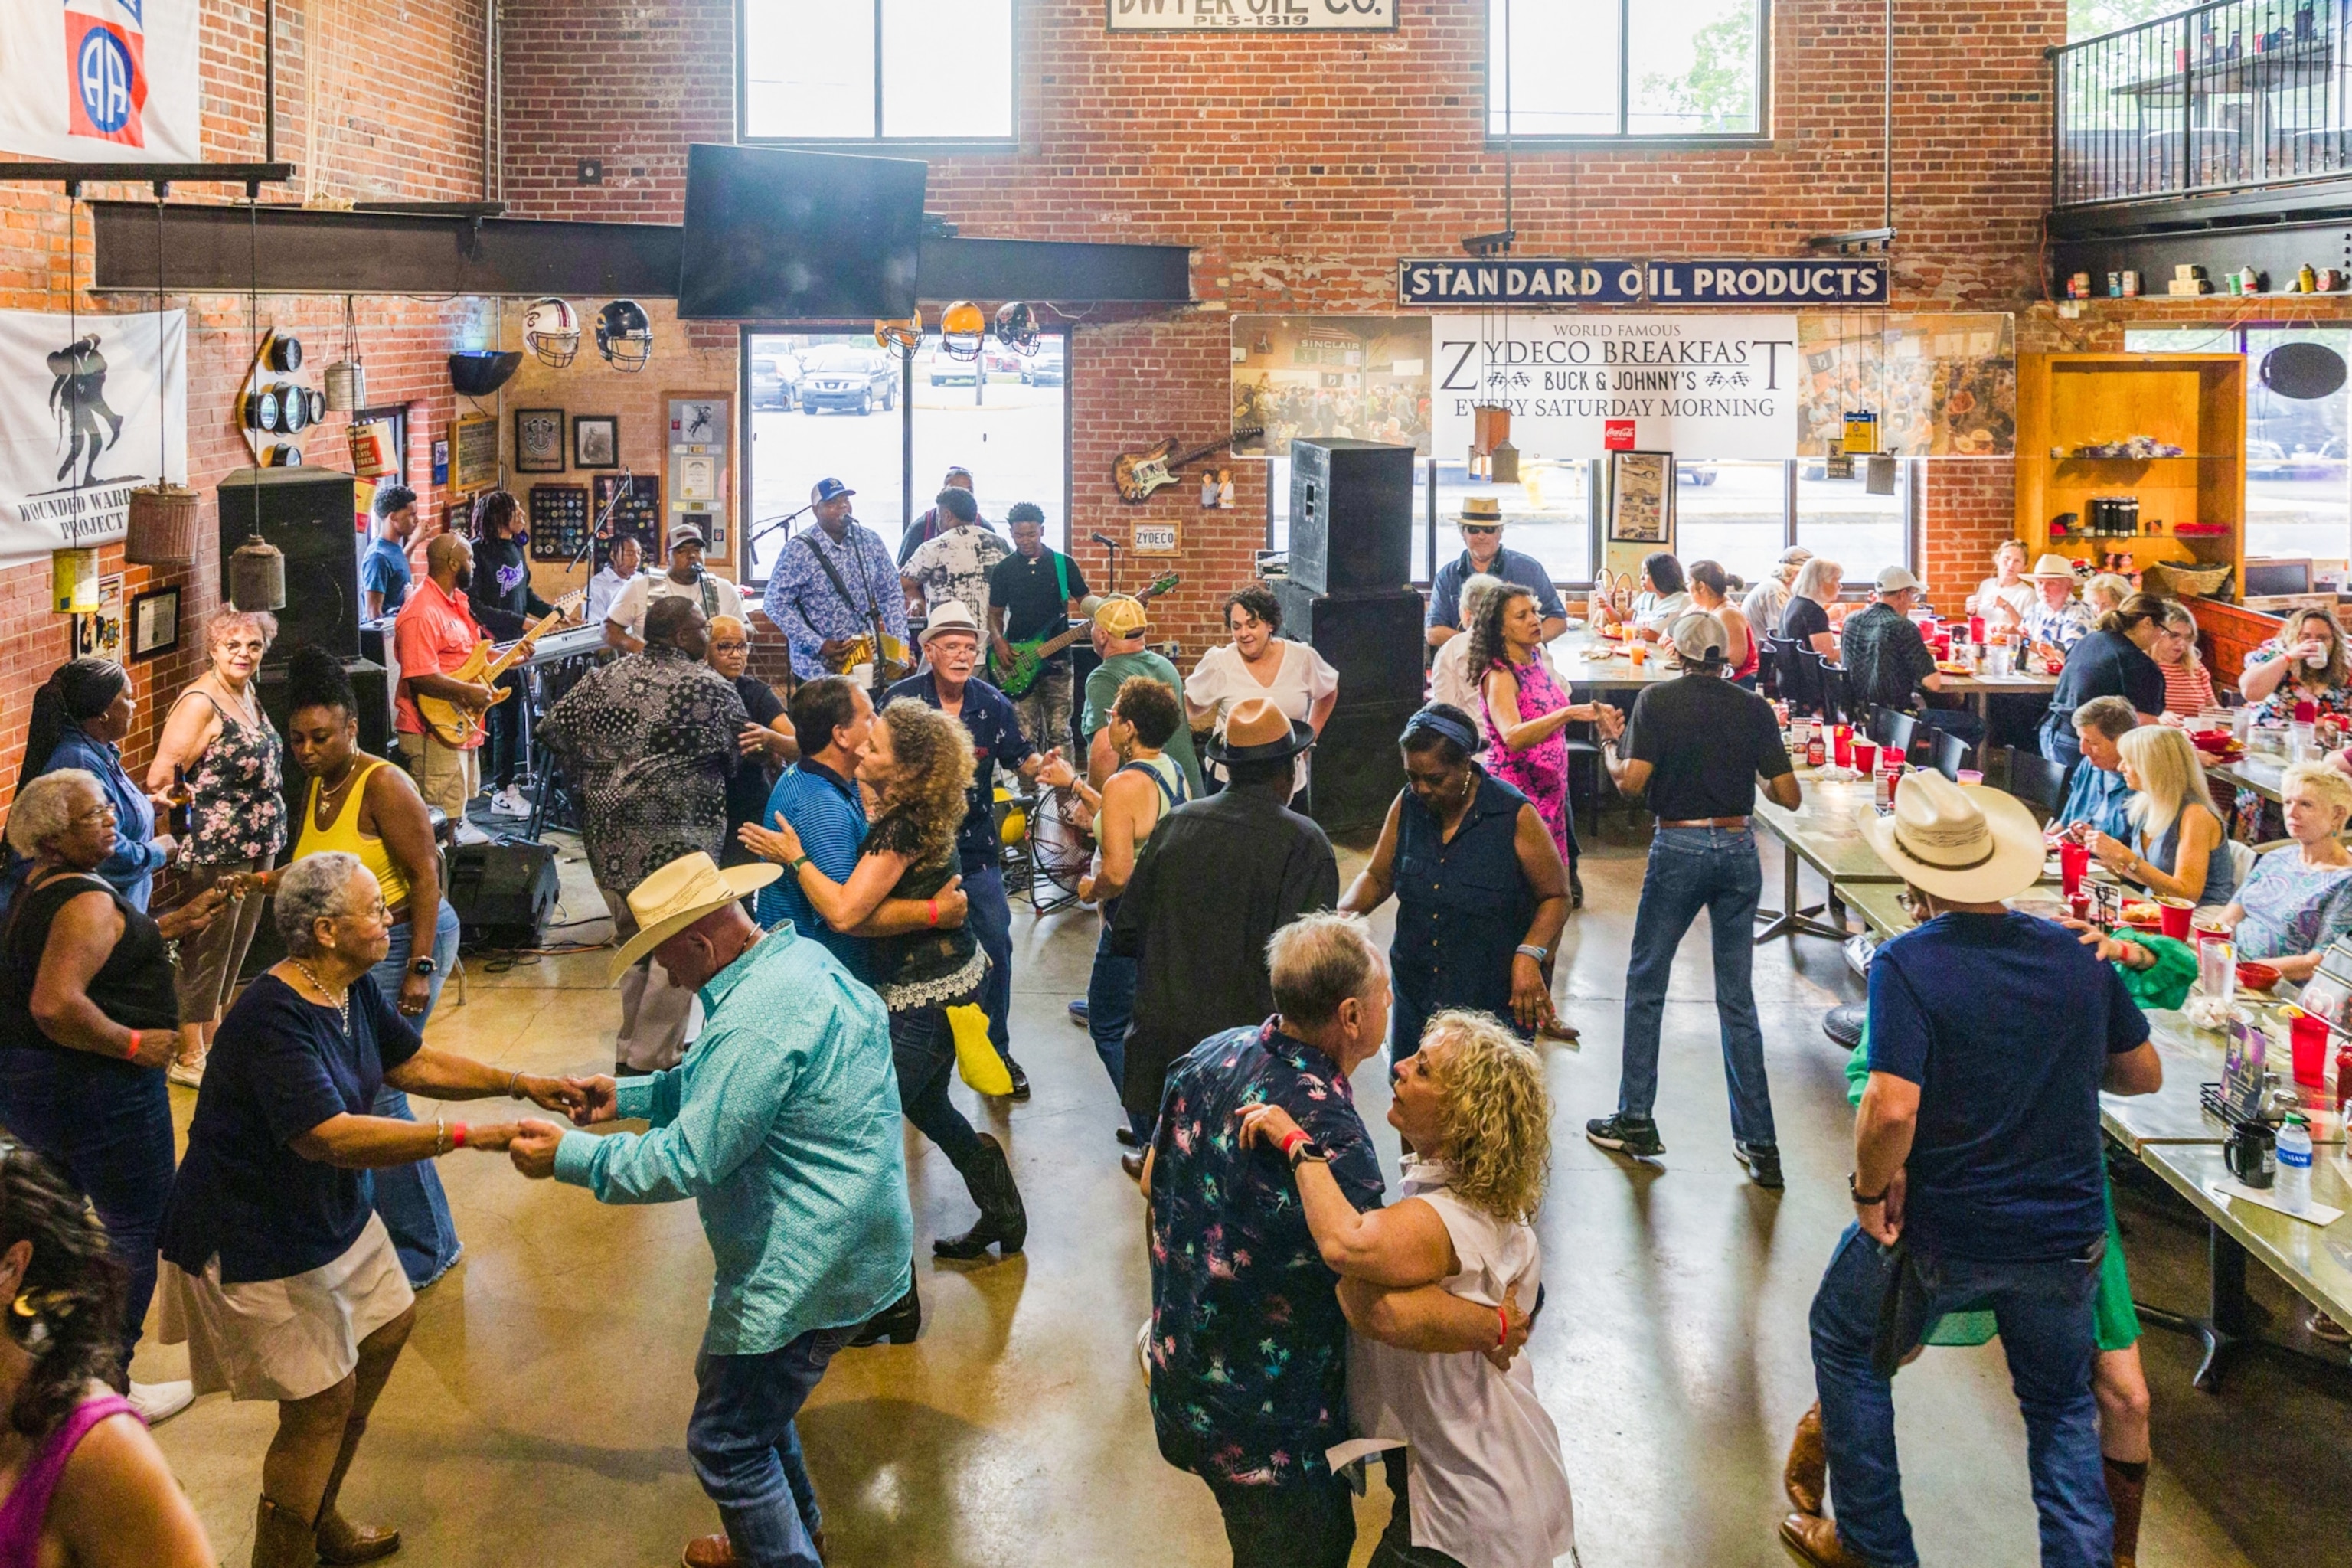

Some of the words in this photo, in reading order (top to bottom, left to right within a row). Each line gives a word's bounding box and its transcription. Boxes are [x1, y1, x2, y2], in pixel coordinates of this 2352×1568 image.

[82, 36, 127, 123] AA
[1412, 268, 1602, 296] STANDARD
[1619, 268, 1681, 296] OIL
[1694, 268, 1877, 296] PRODUCTS
[1553, 325, 1612, 336] WORLD
[1618, 324, 1681, 336] FAMOUS
[1301, 339, 1360, 350] SINCLAIR
[1439, 341, 1590, 390] ZYDECO
[1602, 340, 1794, 390] BREAKFAST
[1544, 371, 1586, 390] BUCK
[1596, 371, 1607, 390] &
[1612, 371, 1697, 390] JOHNNY'S
[1535, 398, 1655, 416] SATURDAY
[1661, 398, 1775, 416] MORNING
[18, 495, 86, 522] WOUNDED
[59, 511, 124, 540] PROJECT
[1136, 532, 1174, 544] ZYDECO
